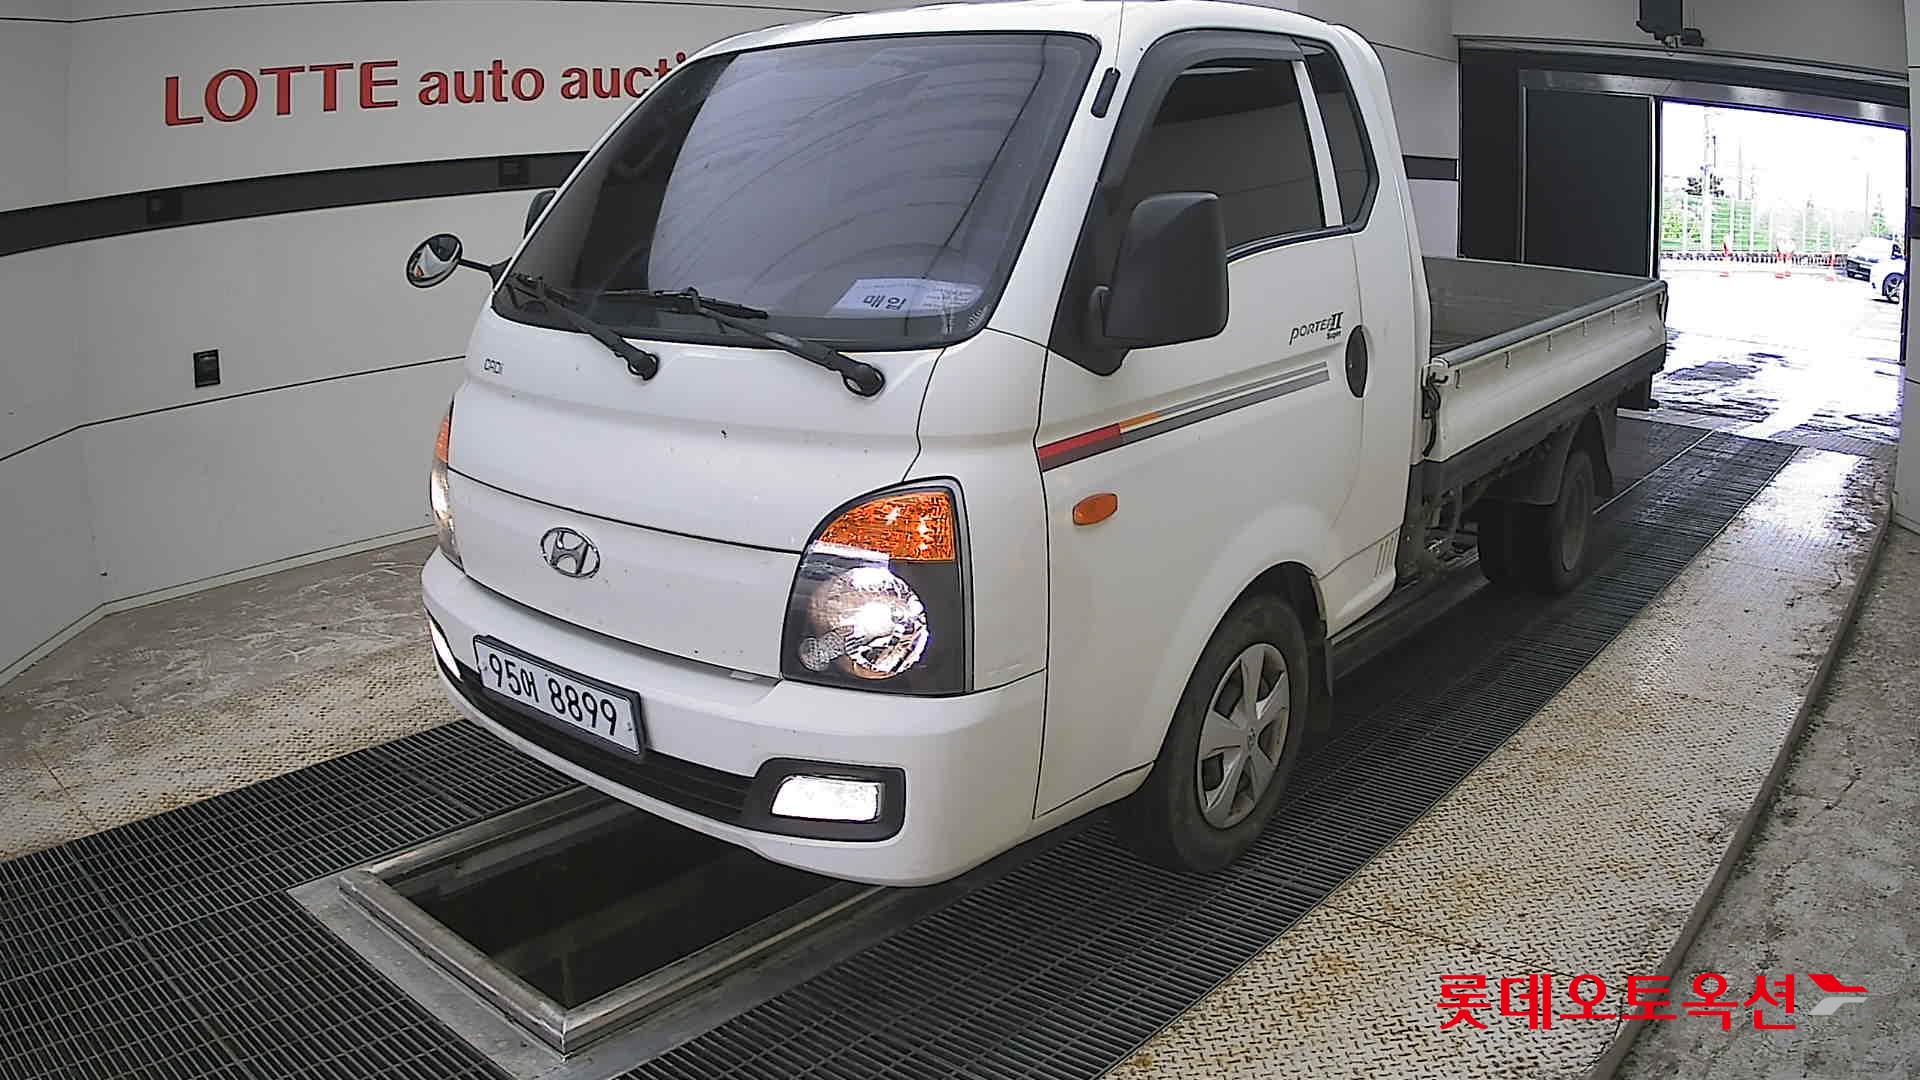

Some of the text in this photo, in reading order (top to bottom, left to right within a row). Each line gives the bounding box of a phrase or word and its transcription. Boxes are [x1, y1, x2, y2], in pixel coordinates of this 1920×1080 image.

[165, 51, 687, 127] LOTTE auto auct
[488, 652, 618, 738] 95어 8899
